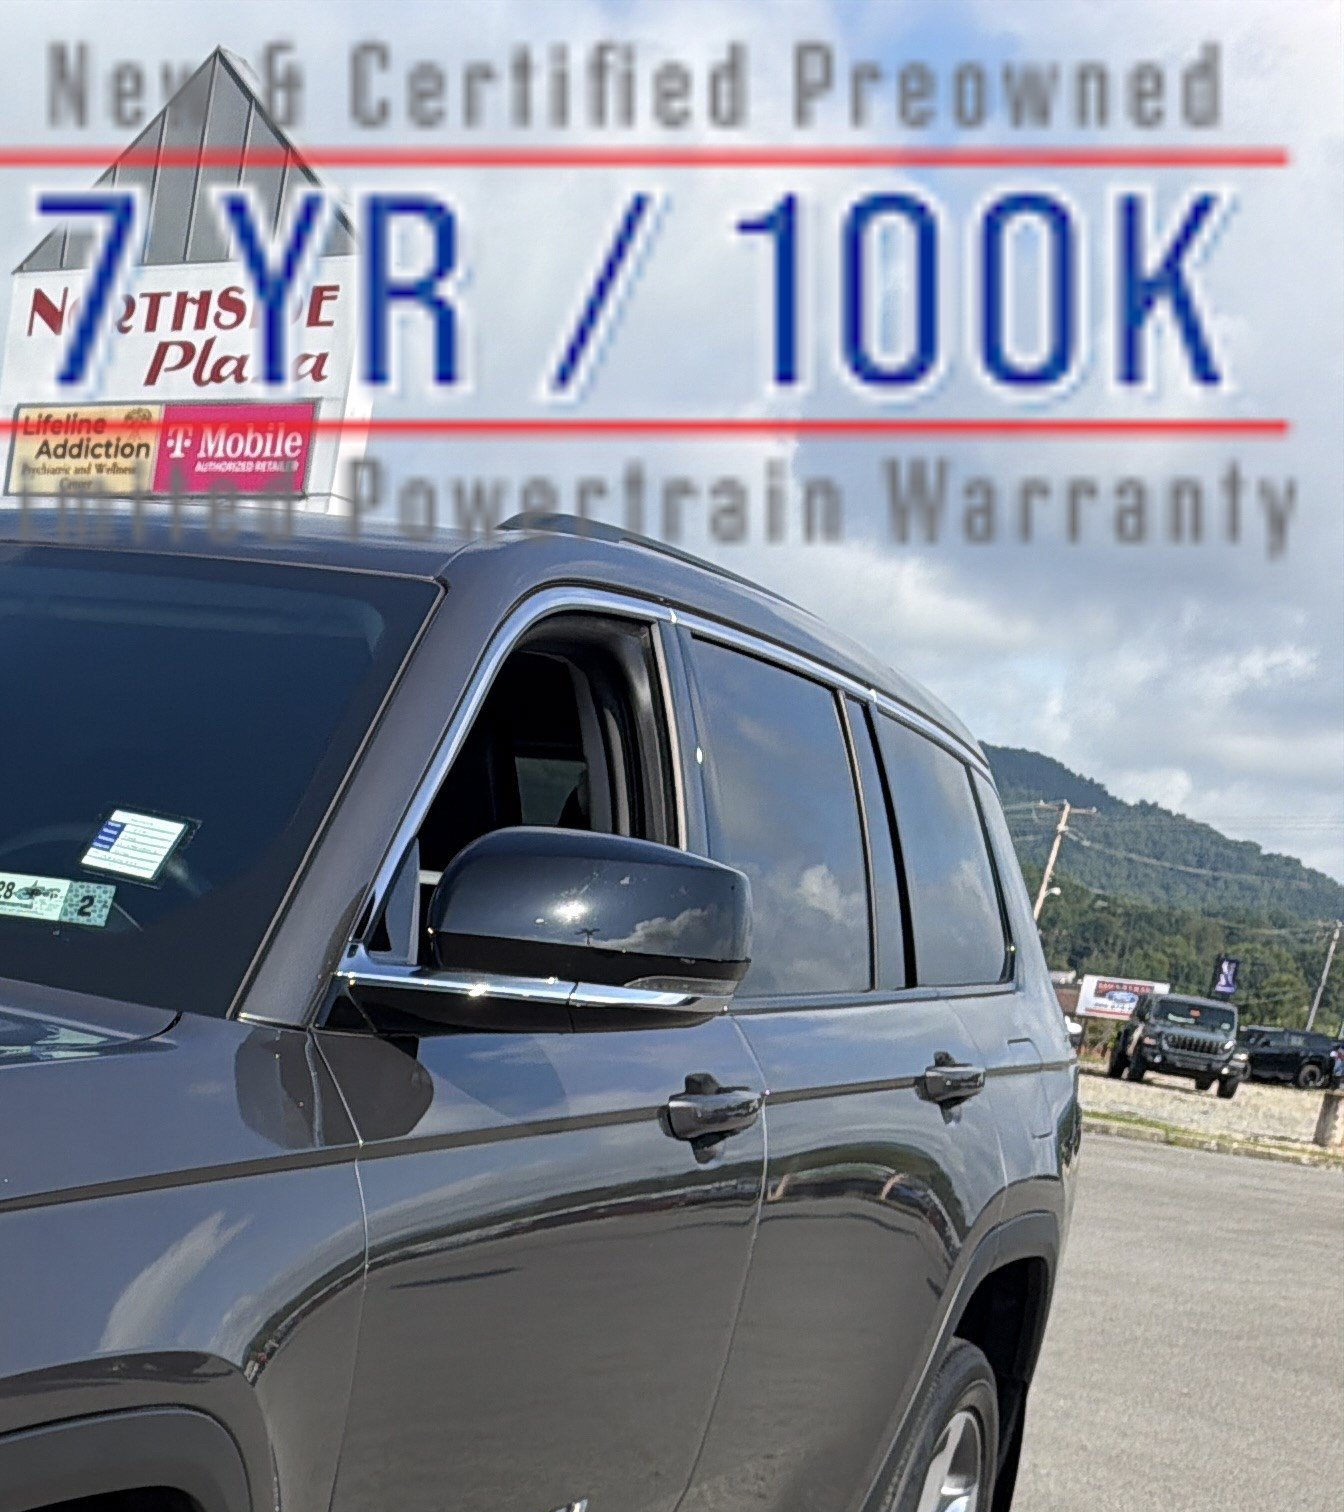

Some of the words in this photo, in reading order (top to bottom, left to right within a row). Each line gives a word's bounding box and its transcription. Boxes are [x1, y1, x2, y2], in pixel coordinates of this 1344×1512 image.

[143, 337, 330, 387] Plaa
[23, 411, 107, 436] Lifeline
[35, 437, 151, 460] Addiction
[196, 423, 303, 458] Mobile
[77, 895, 95, 917] 2
